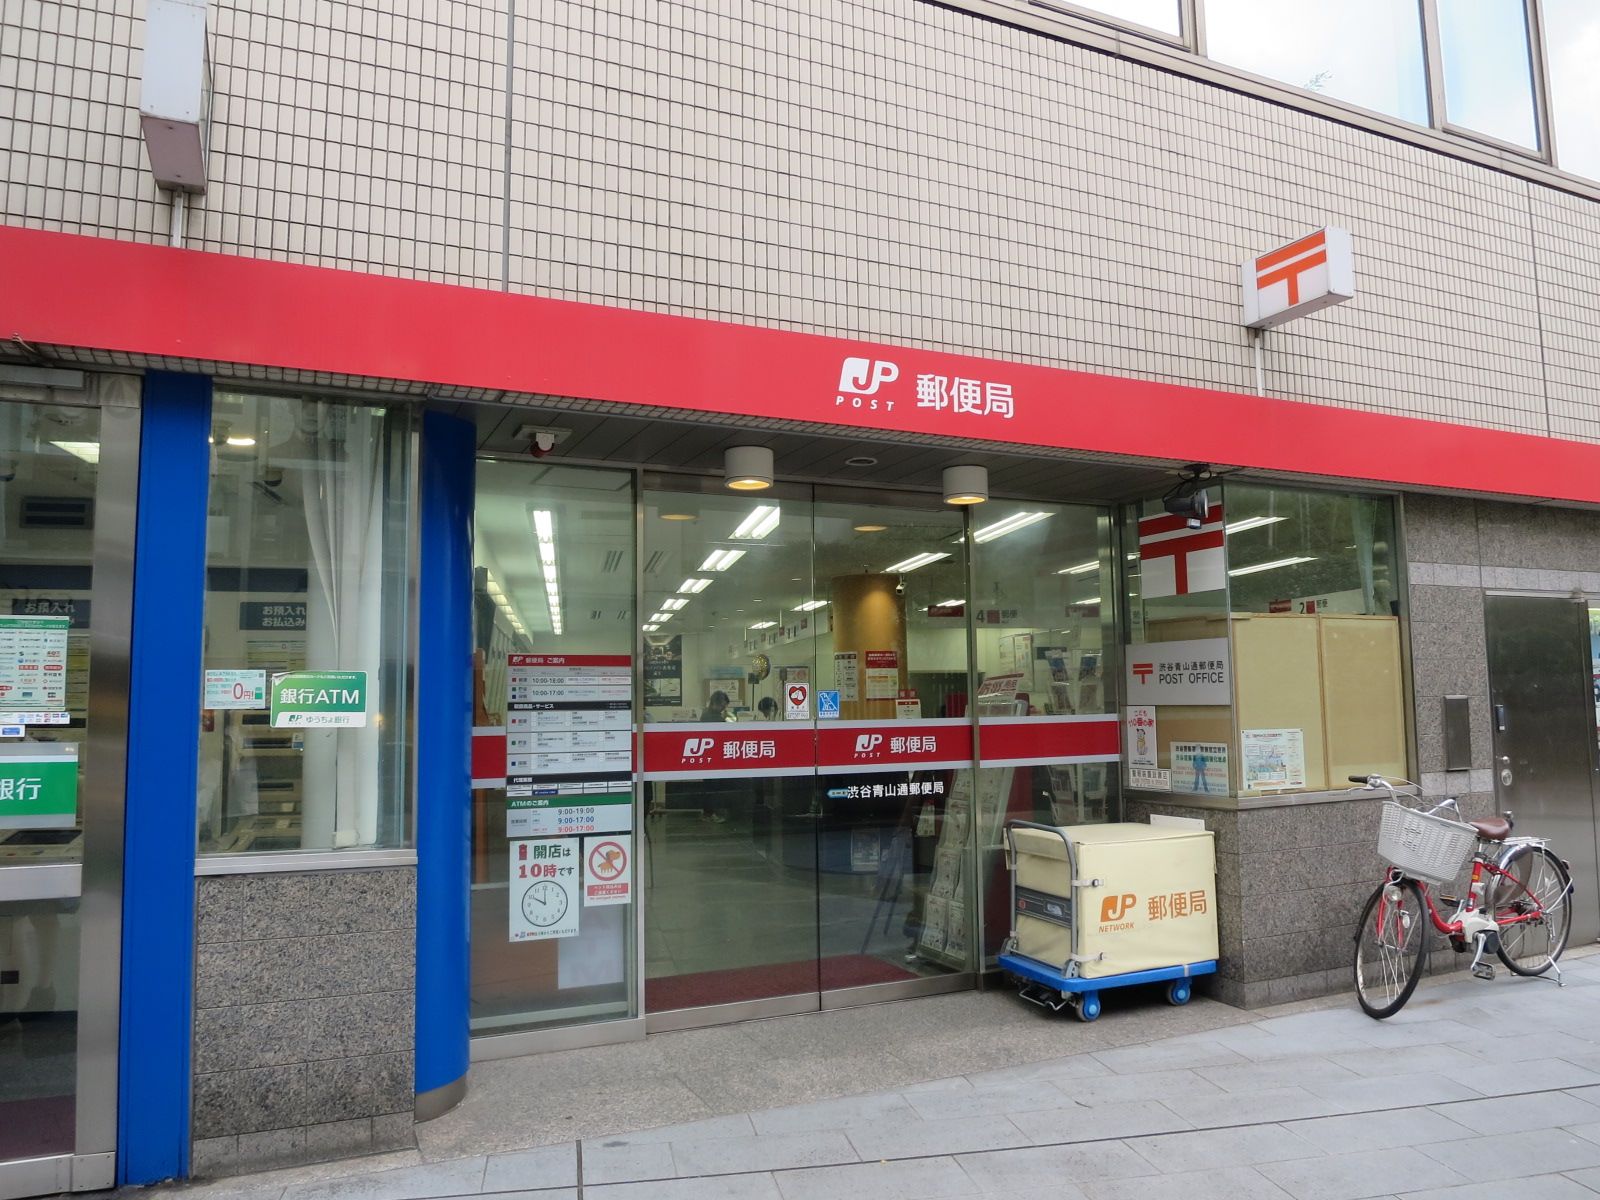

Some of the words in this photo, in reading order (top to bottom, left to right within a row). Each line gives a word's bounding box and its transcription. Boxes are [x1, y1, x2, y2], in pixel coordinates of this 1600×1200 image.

[916, 374, 1015, 418] 郵便局
[835, 396, 895, 412] POST
[1159, 660, 1224, 672] 渋谷青山通郵便局
[1159, 673, 1183, 684] POST
[1188, 672, 1224, 683] OFFICE
[279, 688, 360, 705] 銀行ATM
[723, 740, 776, 760] 郵便局
[890, 736, 937, 754] 郵便局
[847, 781, 944, 799] 渋谷青山通郵便局
[511, 800, 549, 808] ATMのご案内
[557, 807, 595, 815] 9:00-19:00
[557, 816, 595, 824] 9:00-17:00
[557, 825, 595, 833] 9:00-17:00
[533, 844, 571, 860] 開店は
[518, 863, 575, 878] 10時です
[1147, 889, 1208, 921] 郵便局
[1098, 922, 1135, 933] NETWORK
